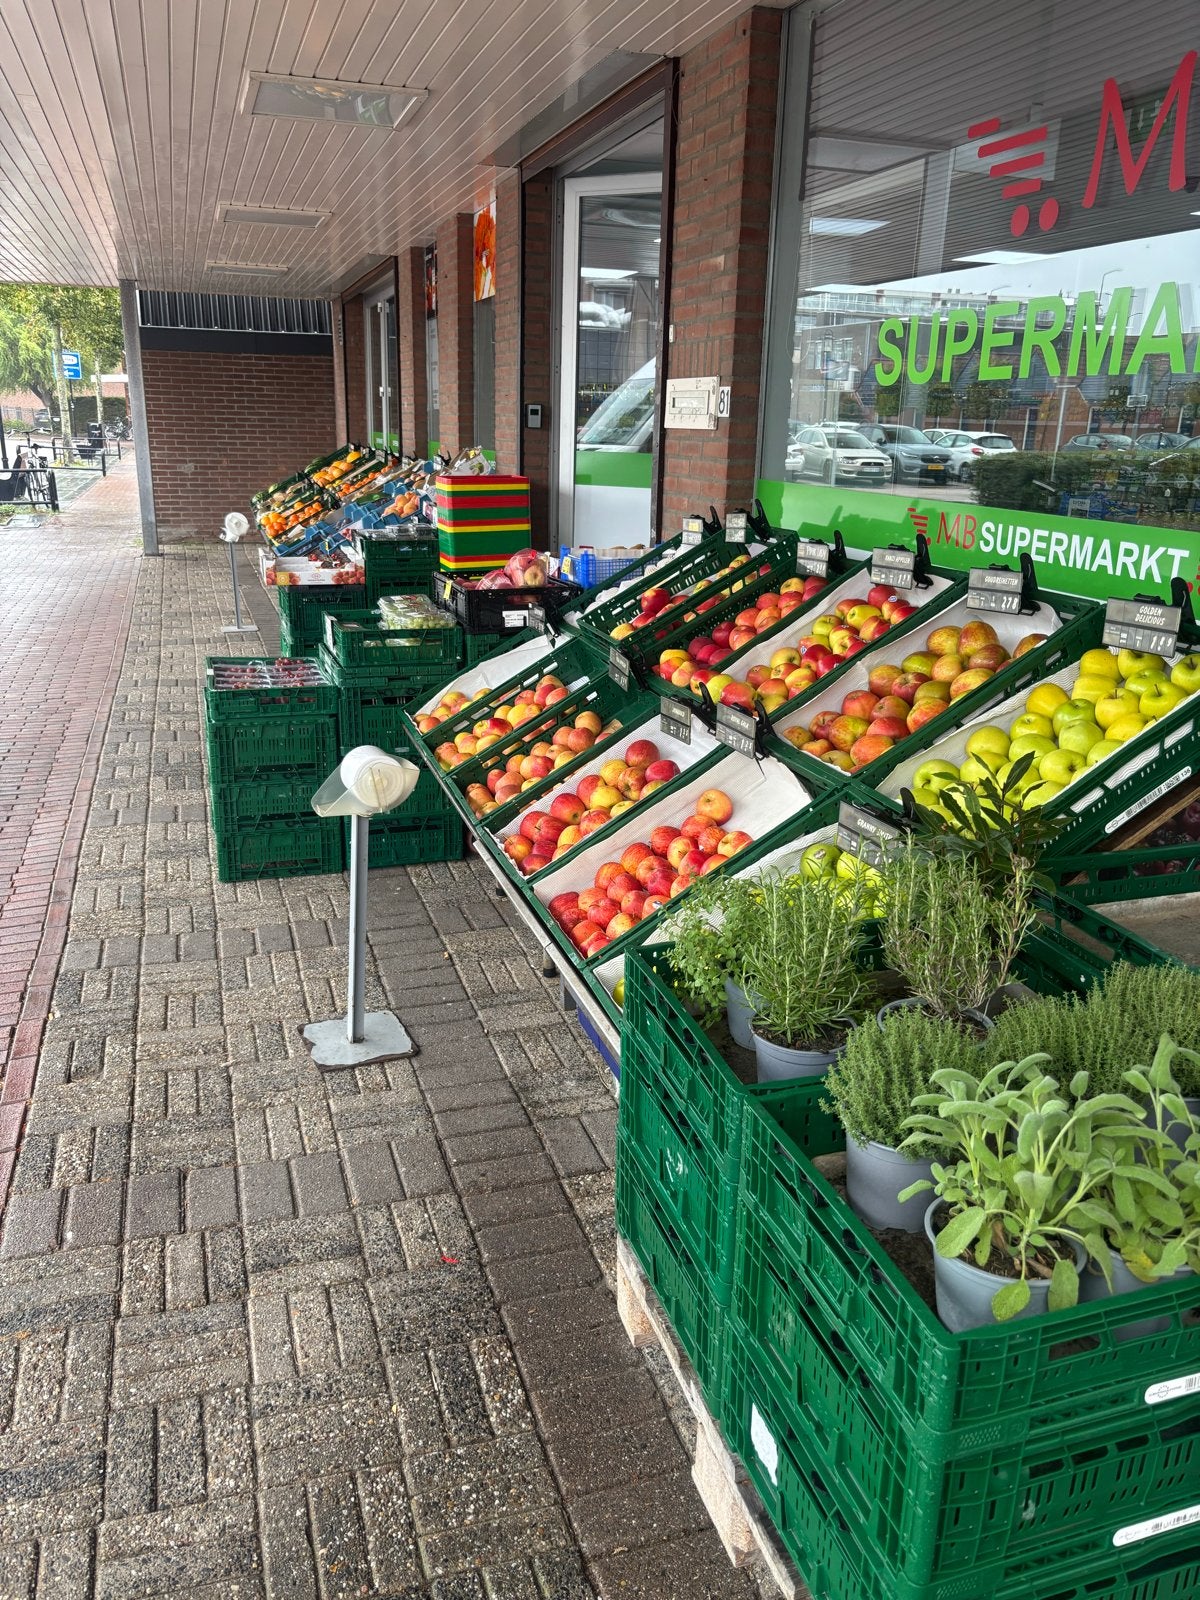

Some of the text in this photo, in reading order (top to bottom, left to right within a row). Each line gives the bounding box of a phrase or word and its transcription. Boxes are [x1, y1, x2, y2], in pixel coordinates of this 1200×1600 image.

[875, 281, 1200, 387] SUPERMA
[718, 389, 729, 414] 81
[937, 511, 1190, 584] MB SUPERMARKT
[1134, 613, 1166, 626] DELICIOUS
[1139, 605, 1163, 616] GOLDEN
